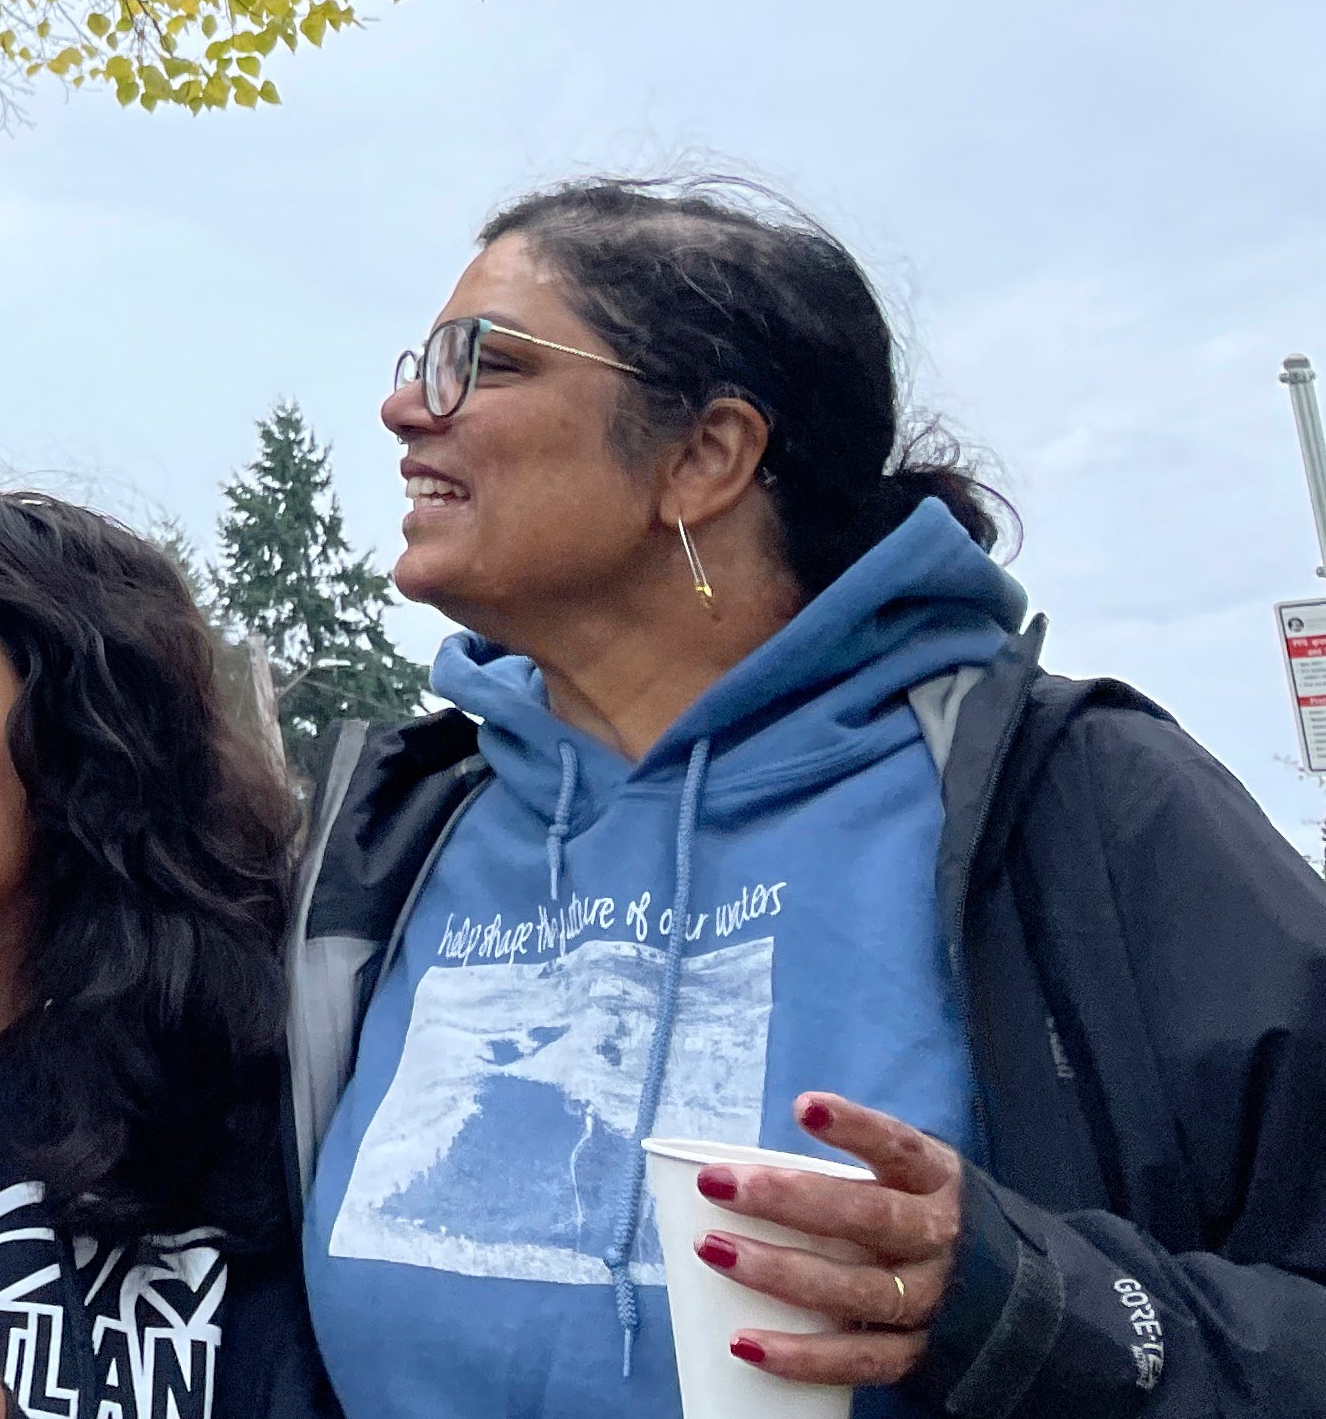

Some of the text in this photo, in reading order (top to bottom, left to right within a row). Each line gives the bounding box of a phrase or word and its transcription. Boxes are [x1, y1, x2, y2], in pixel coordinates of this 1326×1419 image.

[438, 912, 482, 966] help
[479, 913, 534, 969] shape
[626, 891, 651, 942] of
[715, 881, 787, 937] waters
